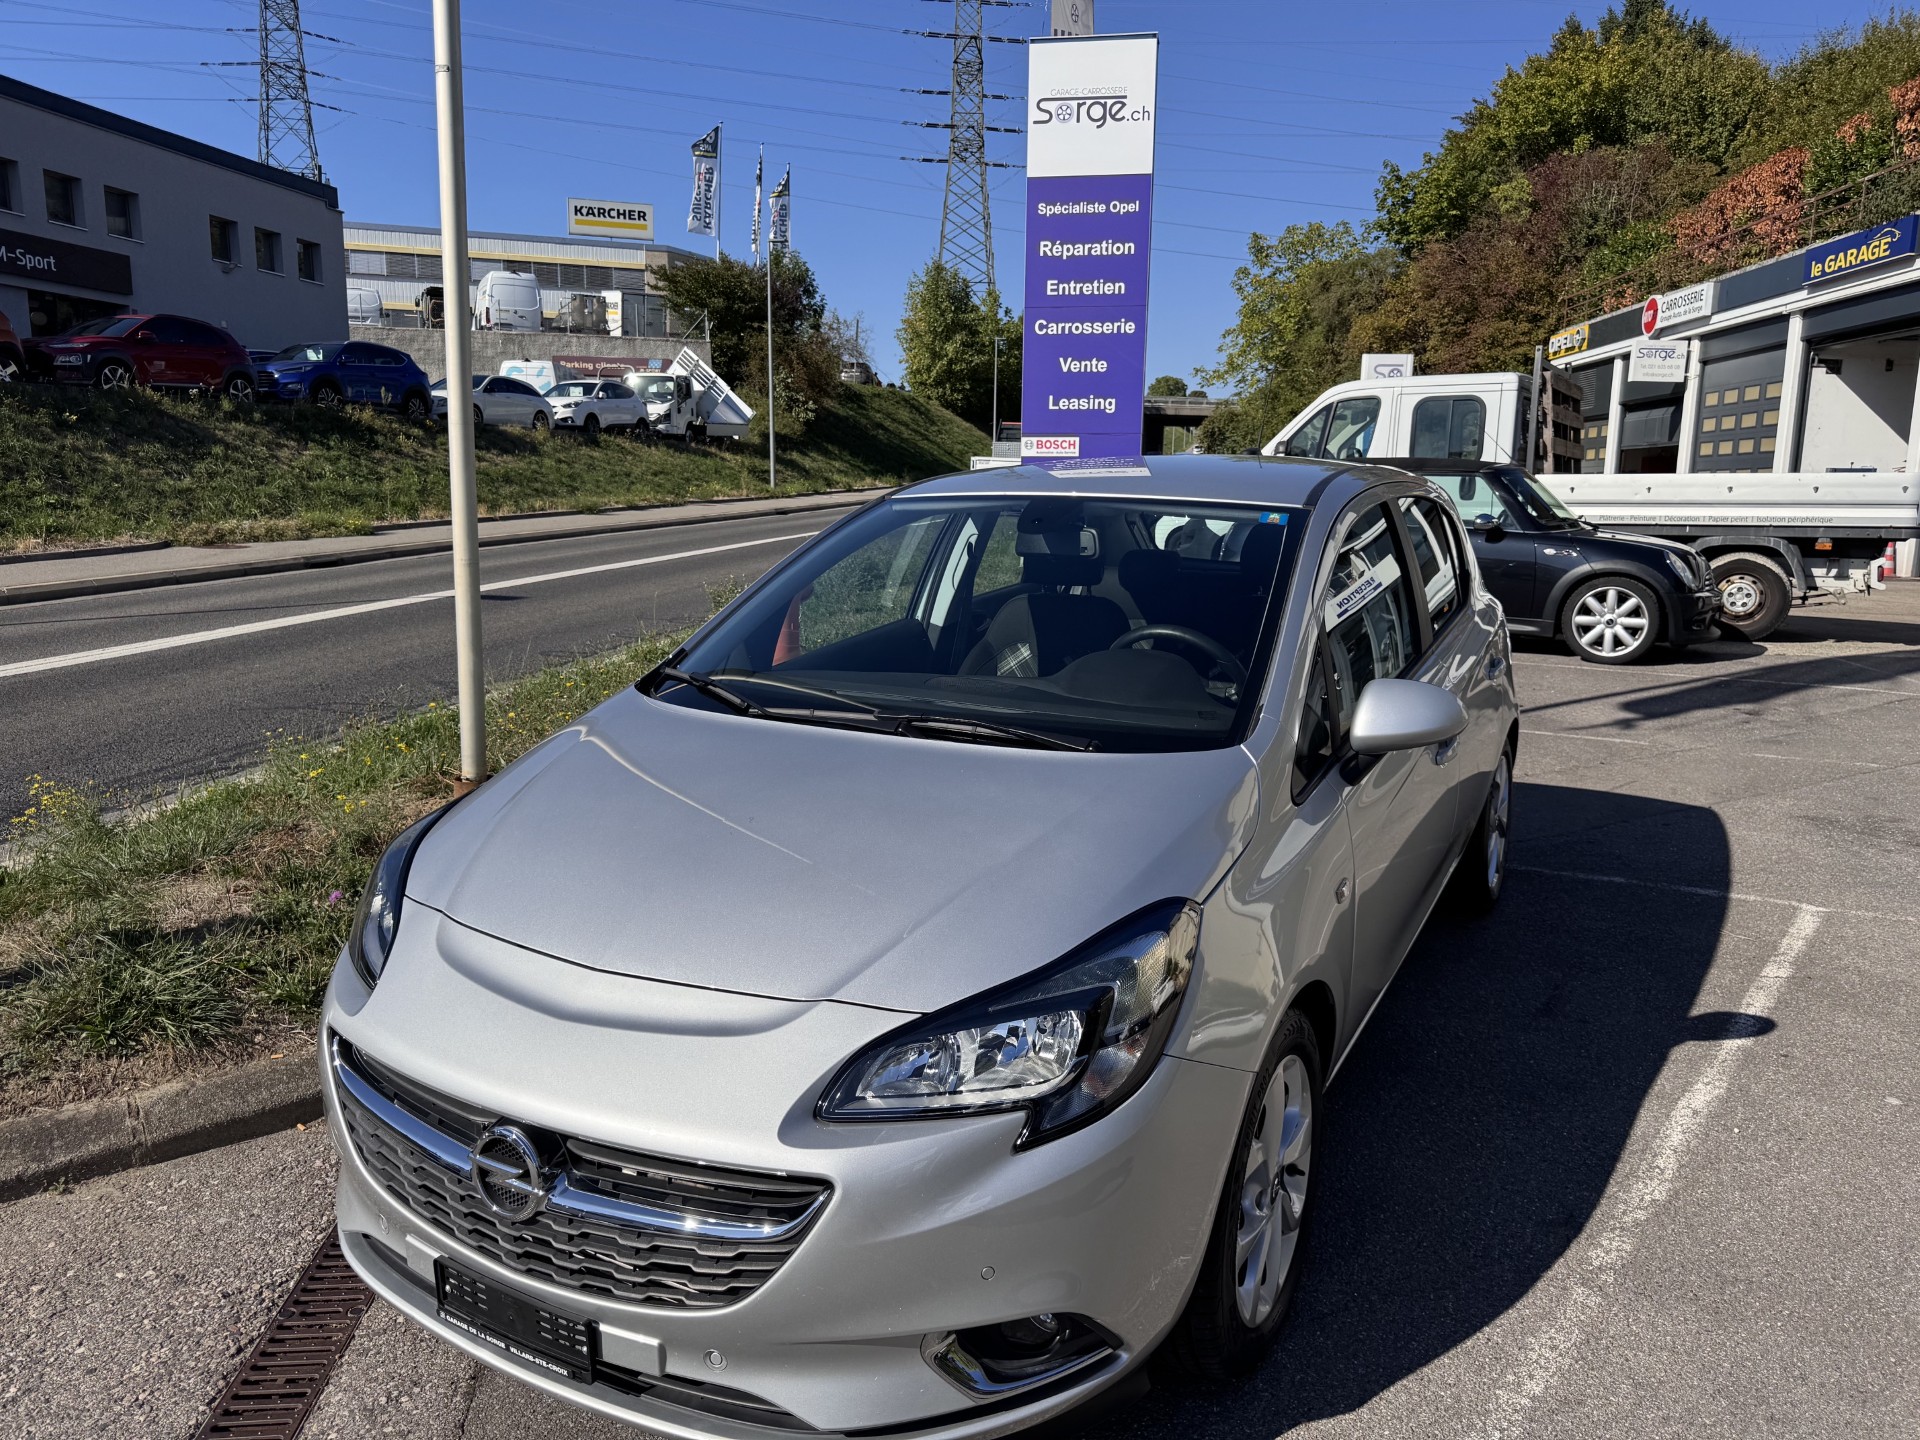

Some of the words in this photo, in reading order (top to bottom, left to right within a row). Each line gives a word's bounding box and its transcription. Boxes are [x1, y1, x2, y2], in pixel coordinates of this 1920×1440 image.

[574, 205, 647, 221] KÄRCHER
[1038, 202, 1106, 217] Spécialiste
[1110, 200, 1139, 215] Opel
[1040, 240, 1135, 260] Réparation
[1811, 261, 1822, 277] le
[1825, 238, 1891, 273] GARAGE
[1046, 279, 1125, 295] Entretien
[1661, 289, 1704, 313] CARROSSERIE
[1034, 319, 1136, 334] Carrosserie
[1549, 334, 1573, 353] OPEL
[1059, 357, 1108, 372] Vente
[1048, 395, 1116, 413] Leasing
[1036, 440, 1076, 449] BOSCH
[1664, 515, 1700, 523] Décoration
[1730, 516, 1748, 524] peint
[1787, 516, 1834, 524] périphérique
[446, 1315, 469, 1331] GARAGE
[469, 1326, 477, 1335] DE
[478, 1331, 485, 1339] LA
